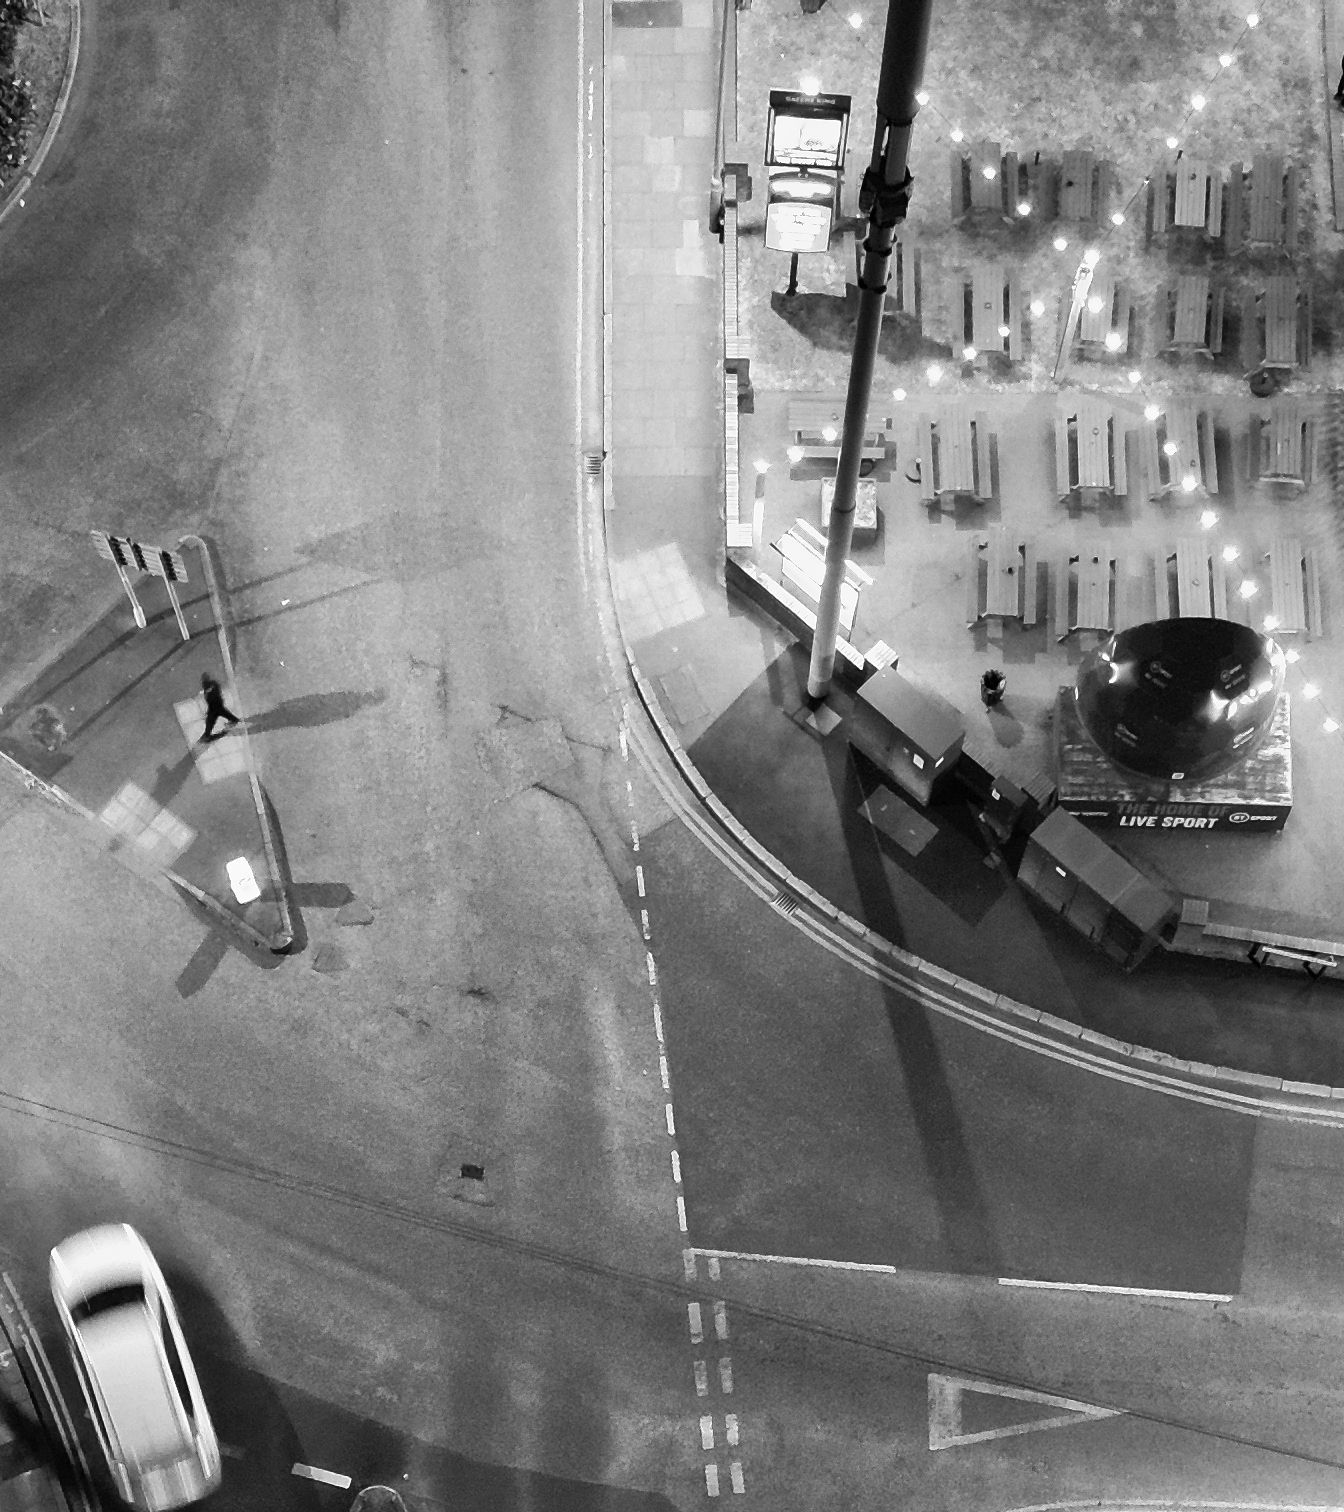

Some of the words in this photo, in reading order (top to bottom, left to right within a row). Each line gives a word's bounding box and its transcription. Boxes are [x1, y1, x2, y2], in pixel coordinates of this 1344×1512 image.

[1116, 802, 1148, 814] THE
[1154, 803, 1200, 815] HOME
[1119, 815, 1158, 827] LIVE
[1161, 816, 1219, 829] SPORT
